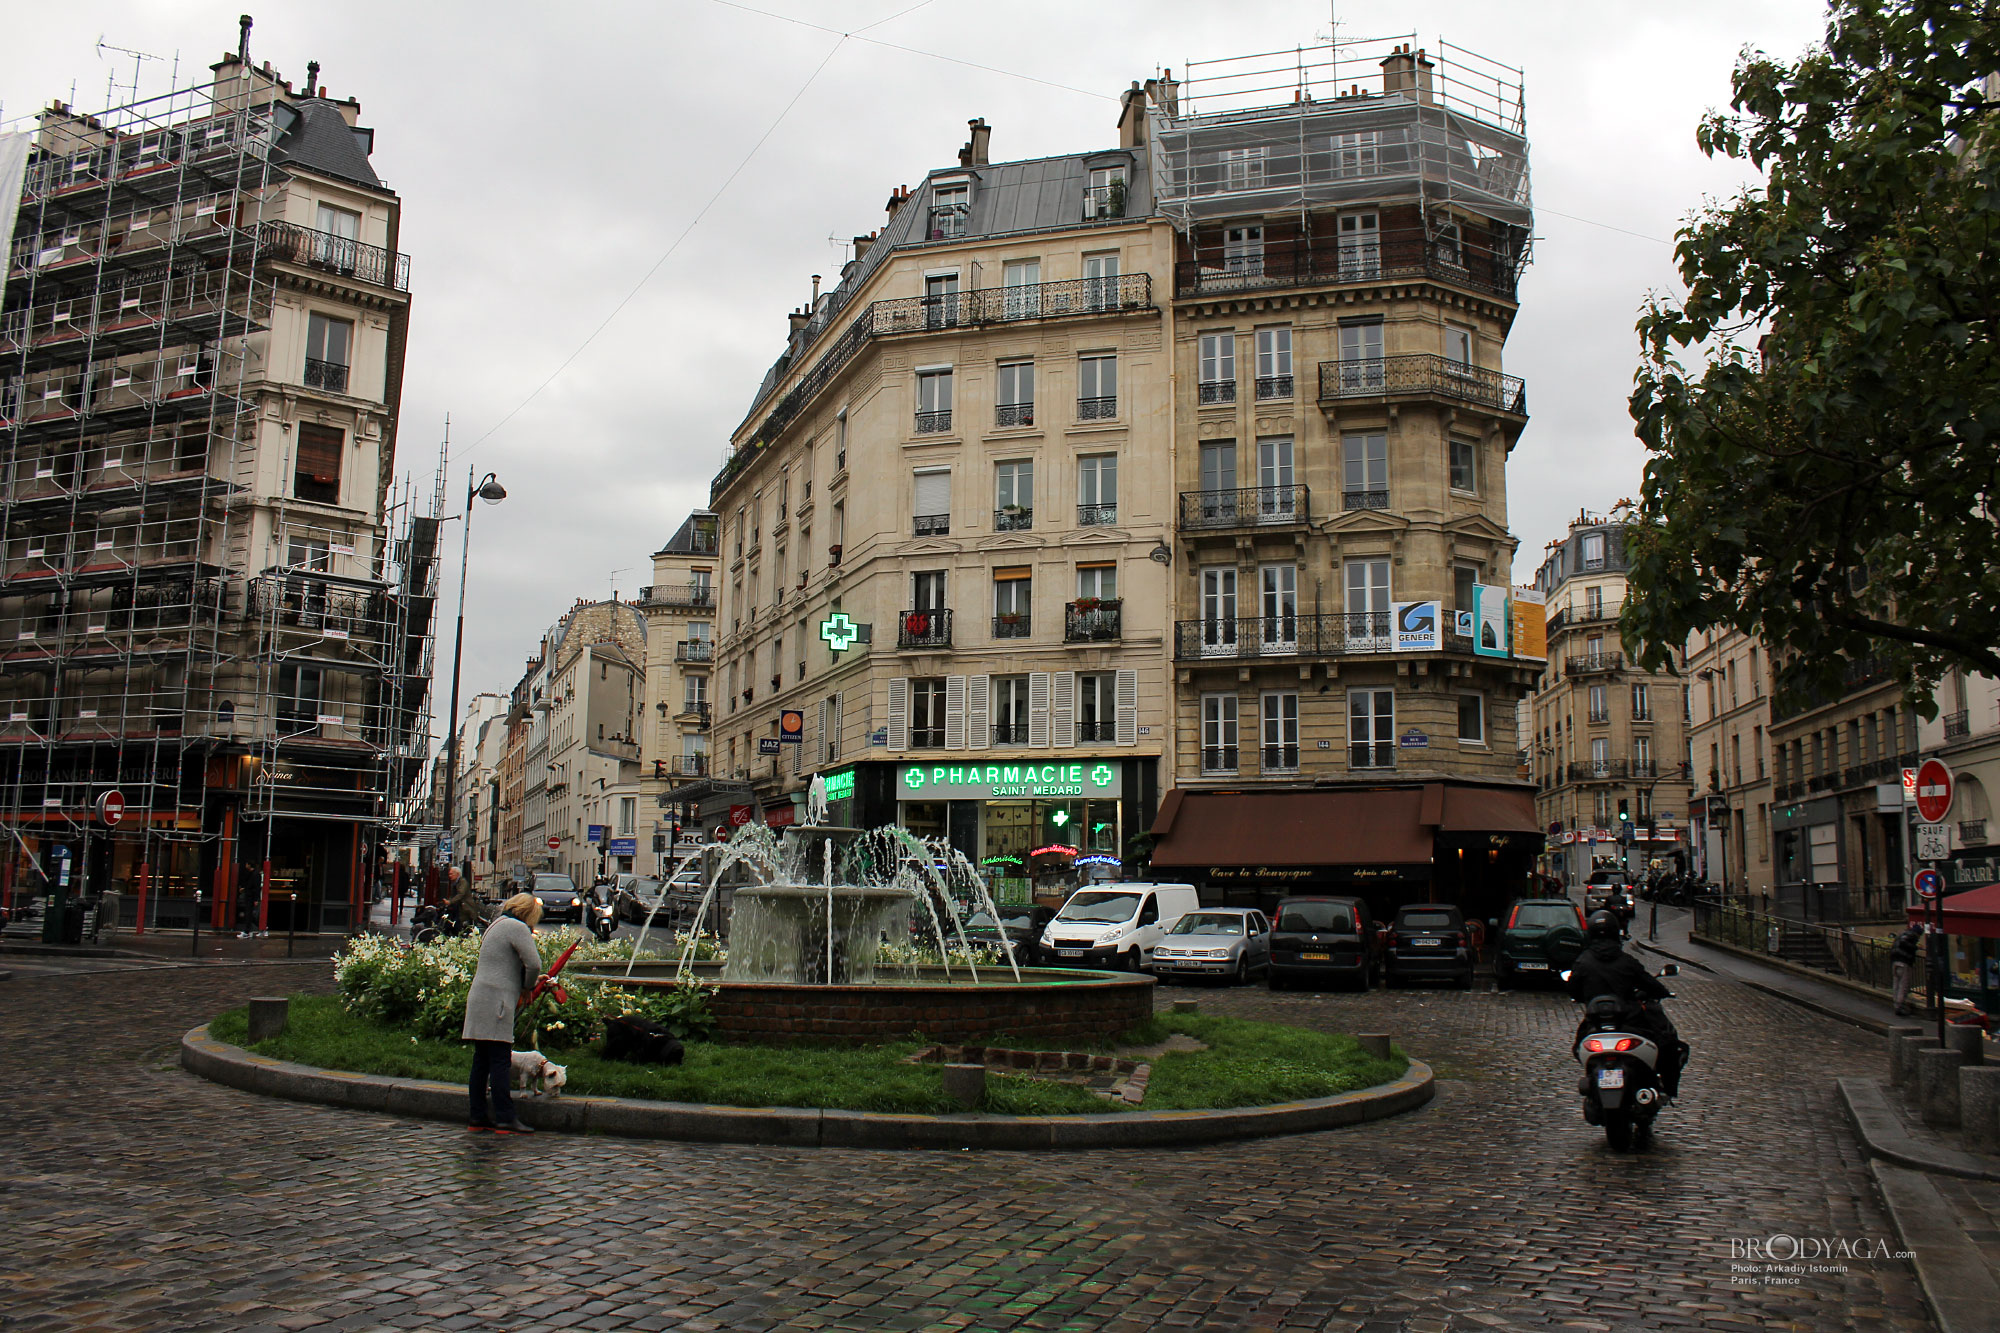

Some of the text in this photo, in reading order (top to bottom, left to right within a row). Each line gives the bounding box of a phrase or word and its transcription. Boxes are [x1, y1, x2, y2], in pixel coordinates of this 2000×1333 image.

[761, 740, 779, 748] JAZ
[932, 765, 1083, 784] PHARMACIE
[992, 785, 1083, 796] SAINT MEDARD
[1922, 826, 1944, 835] SAUF
[1209, 867, 1313, 880] Cave la Bourgogne
[1353, 868, 1377, 879] depuis
[1953, 867, 1995, 883] LIBRAIRIE
